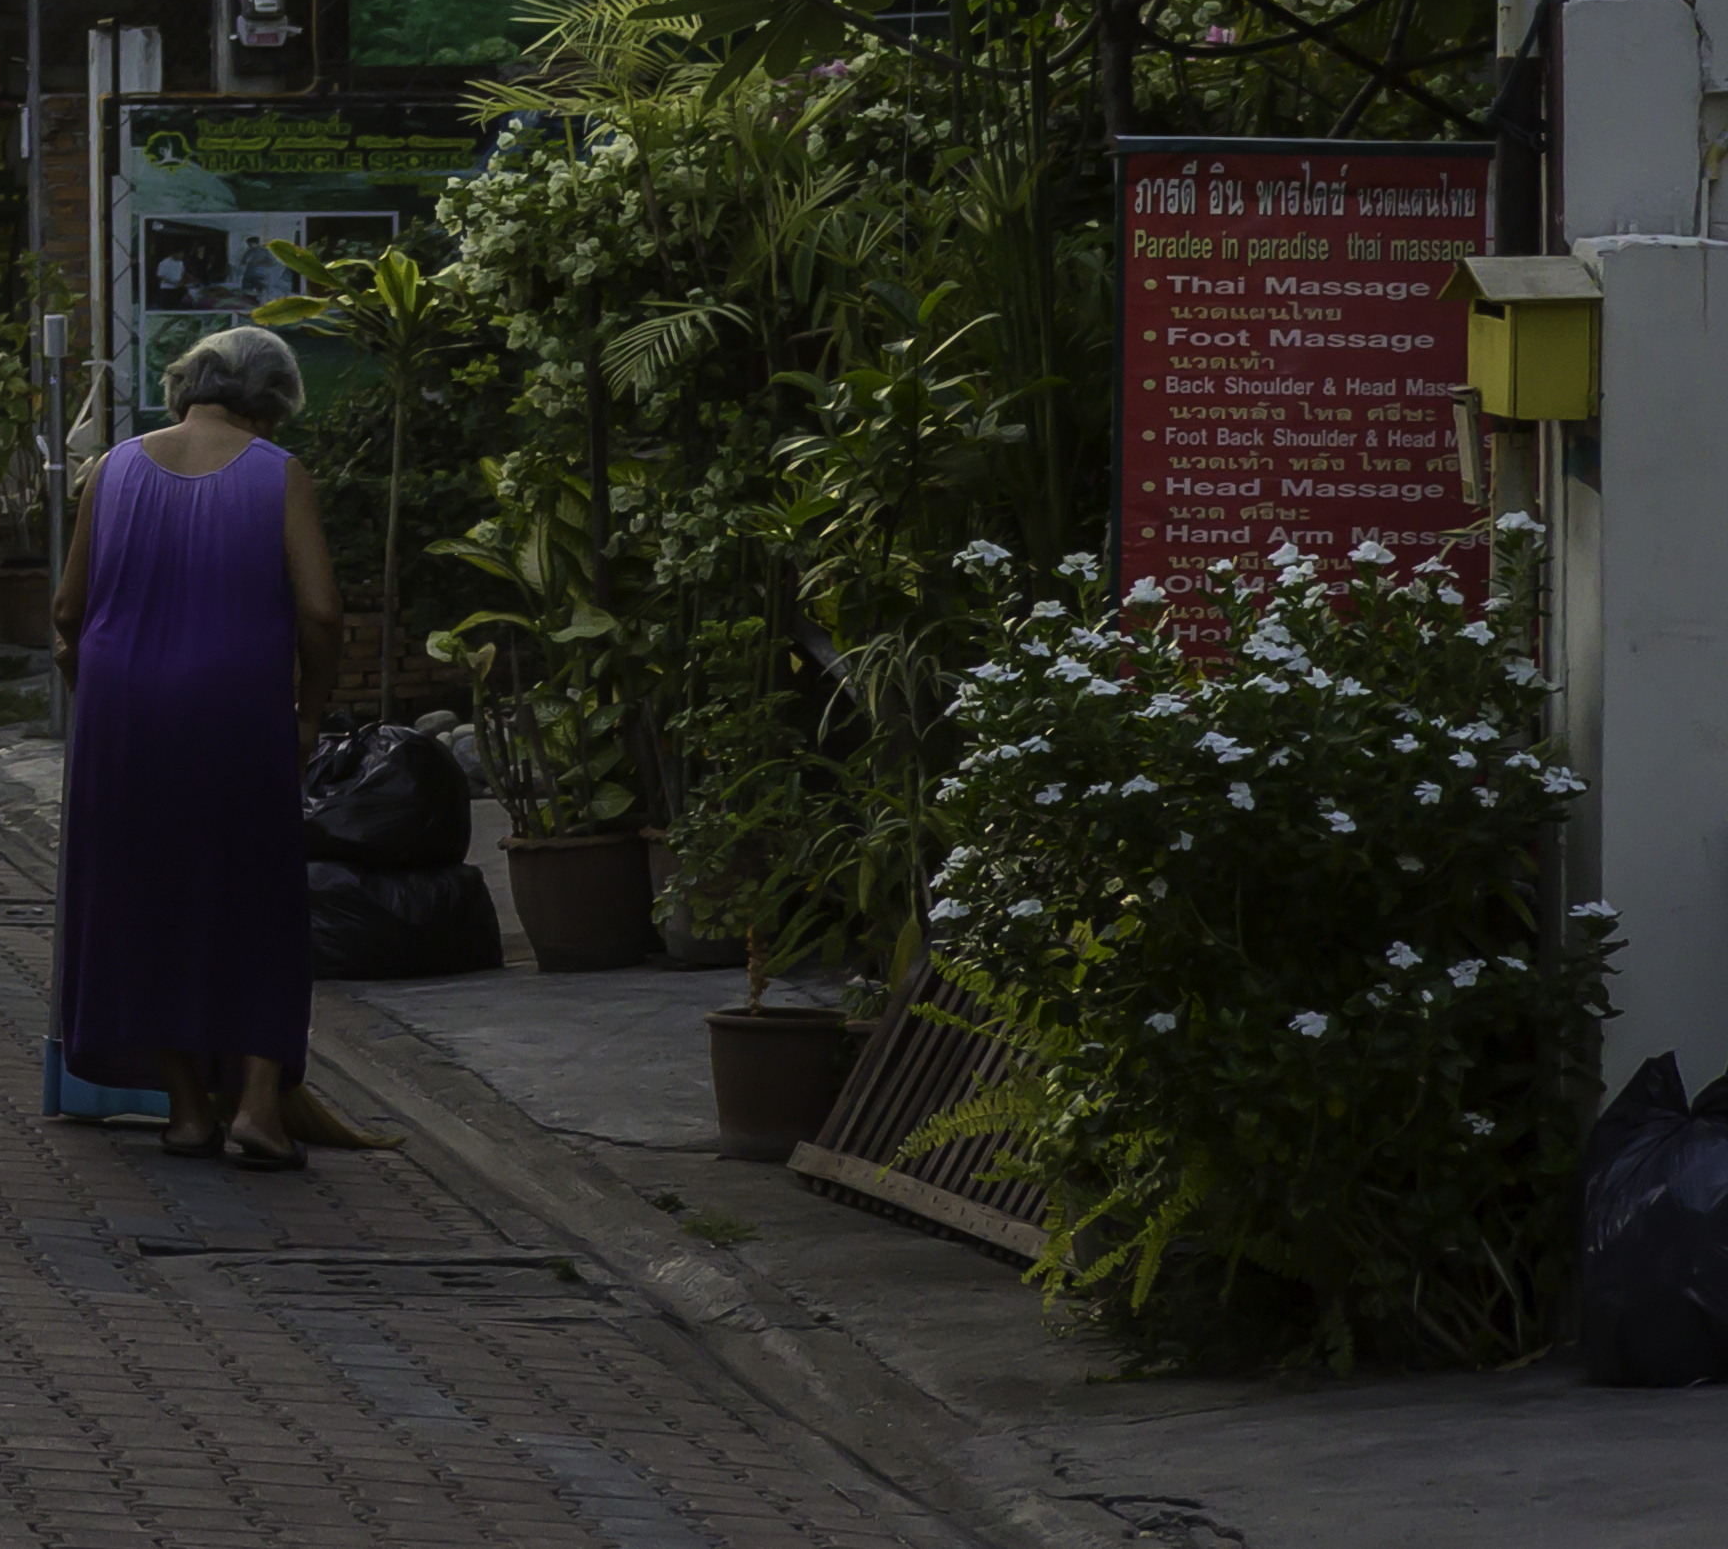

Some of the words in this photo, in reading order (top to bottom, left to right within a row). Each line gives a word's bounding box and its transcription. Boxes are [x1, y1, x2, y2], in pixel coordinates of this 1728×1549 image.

[197, 153, 261, 171] THAI
[270, 152, 363, 171] JUNGLE
[1207, 162, 1245, 217] อิน
[1357, 172, 1478, 218] นวดแผนไทย
[1133, 229, 1213, 261] Paradee
[1220, 230, 1239, 261] in
[1247, 231, 1330, 267] paradise
[1346, 231, 1383, 262] thai
[1390, 238, 1477, 264] massage
[1166, 275, 1246, 296] Thai
[1264, 276, 1431, 301] Massage
[1170, 301, 1343, 322] นวดแผนไทย
[1166, 328, 1251, 348] Foot
[1269, 328, 1436, 353] Massage
[1169, 350, 1275, 372] นวดเท้า
[1165, 376, 1216, 396] Back
[1224, 377, 1315, 397] Shoulder
[1322, 378, 1337, 397] &
[1346, 378, 1397, 397] Head
[1169, 401, 1287, 422] นวดหลัง
[1165, 428, 1208, 447] Foot
[1216, 428, 1265, 447] Back
[1272, 428, 1358, 448] Shoulder
[1365, 429, 1379, 448] &
[1387, 429, 1437, 448] Head
[1168, 450, 1275, 472] นวดเท้า
[1288, 452, 1345, 472] หลัง
[1165, 477, 1262, 497] Head
[1280, 479, 1445, 504] Massage
[1168, 503, 1226, 521] นวด
[1165, 525, 1252, 545] Hand
[1266, 526, 1334, 546] Arm
